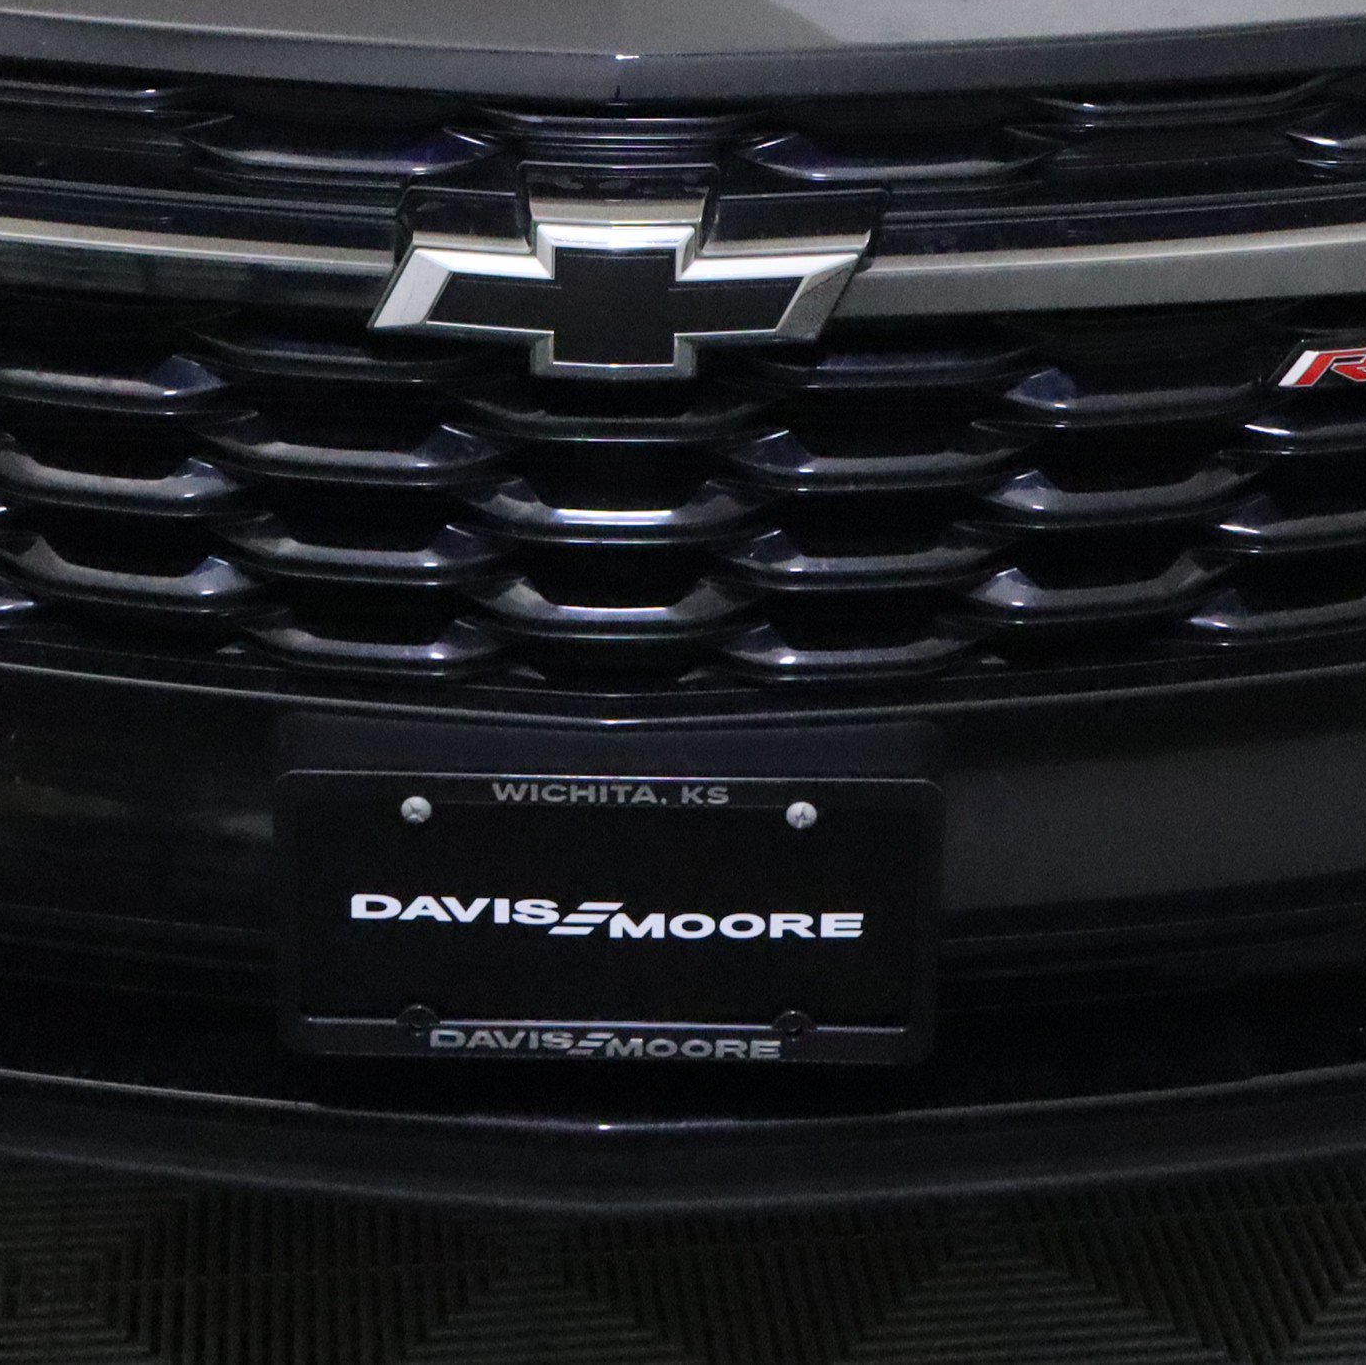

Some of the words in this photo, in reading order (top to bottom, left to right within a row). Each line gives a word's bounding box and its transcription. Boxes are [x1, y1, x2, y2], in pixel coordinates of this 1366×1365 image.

[680, 785, 730, 805] KS
[350, 893, 560, 925] DAVIS
[609, 912, 864, 939] MOORE
[429, 1028, 575, 1050] DAVIS
[605, 1037, 782, 1060] MOORE
